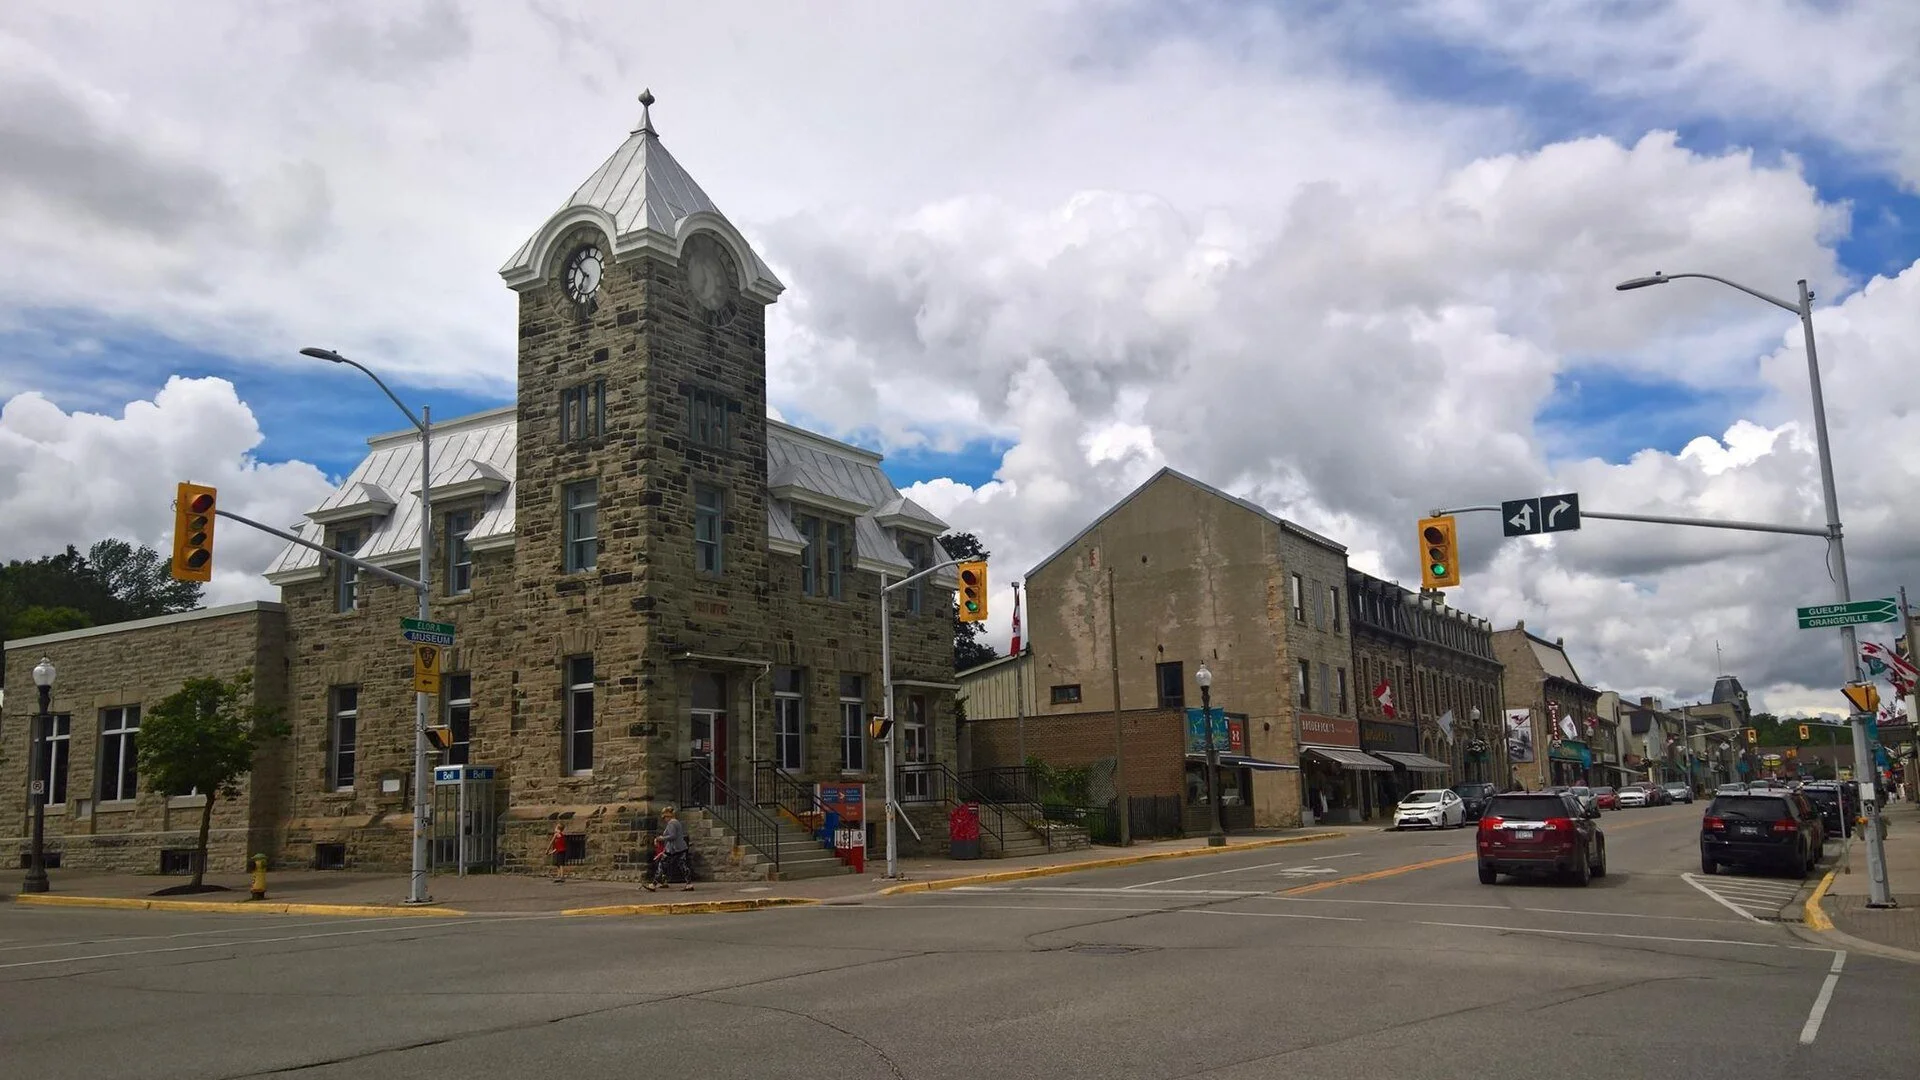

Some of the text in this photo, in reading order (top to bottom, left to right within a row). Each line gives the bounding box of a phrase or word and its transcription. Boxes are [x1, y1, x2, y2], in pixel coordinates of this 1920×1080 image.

[1808, 605, 1847, 615] GUELPH
[1808, 614, 1868, 627] ORANGEVILLE
[417, 621, 441, 632] ELORA
[411, 632, 450, 644] MUSEUM
[442, 771, 454, 780] Bell
